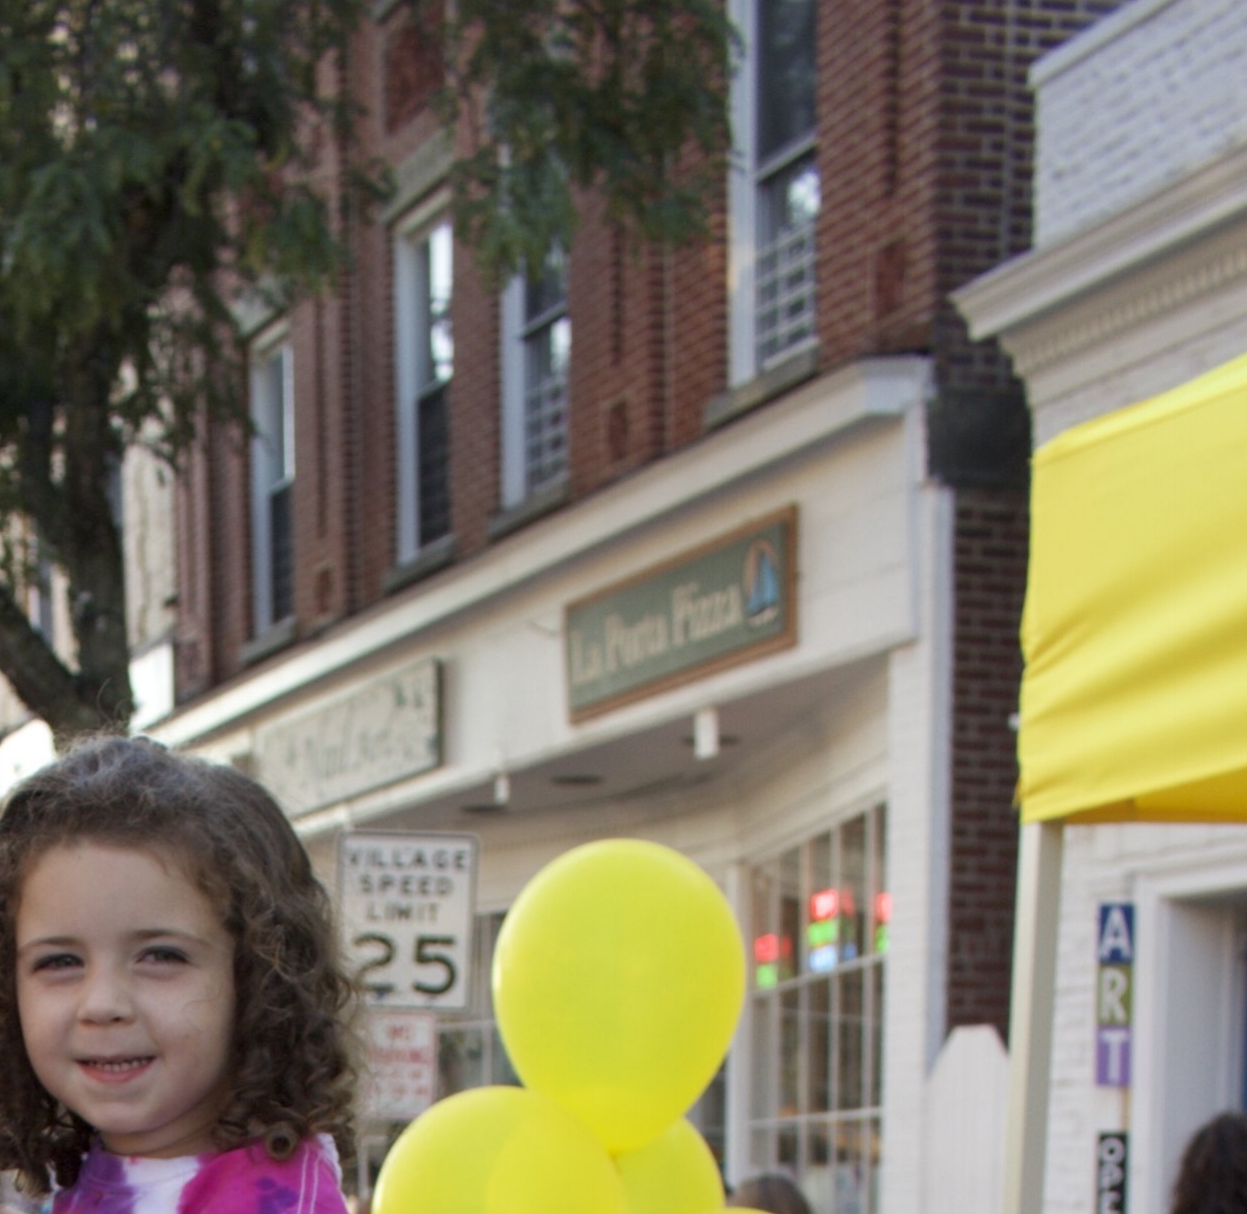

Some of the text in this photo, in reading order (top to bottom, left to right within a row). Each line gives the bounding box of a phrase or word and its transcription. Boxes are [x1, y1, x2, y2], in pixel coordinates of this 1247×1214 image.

[571, 630, 601, 685] La
[672, 582, 742, 647] Pizza
[350, 849, 467, 870] VILLAGE
[360, 875, 453, 896] SPEED
[366, 902, 439, 922] LIMIT
[354, 933, 457, 996] 25
[1099, 905, 1131, 1084] ART
